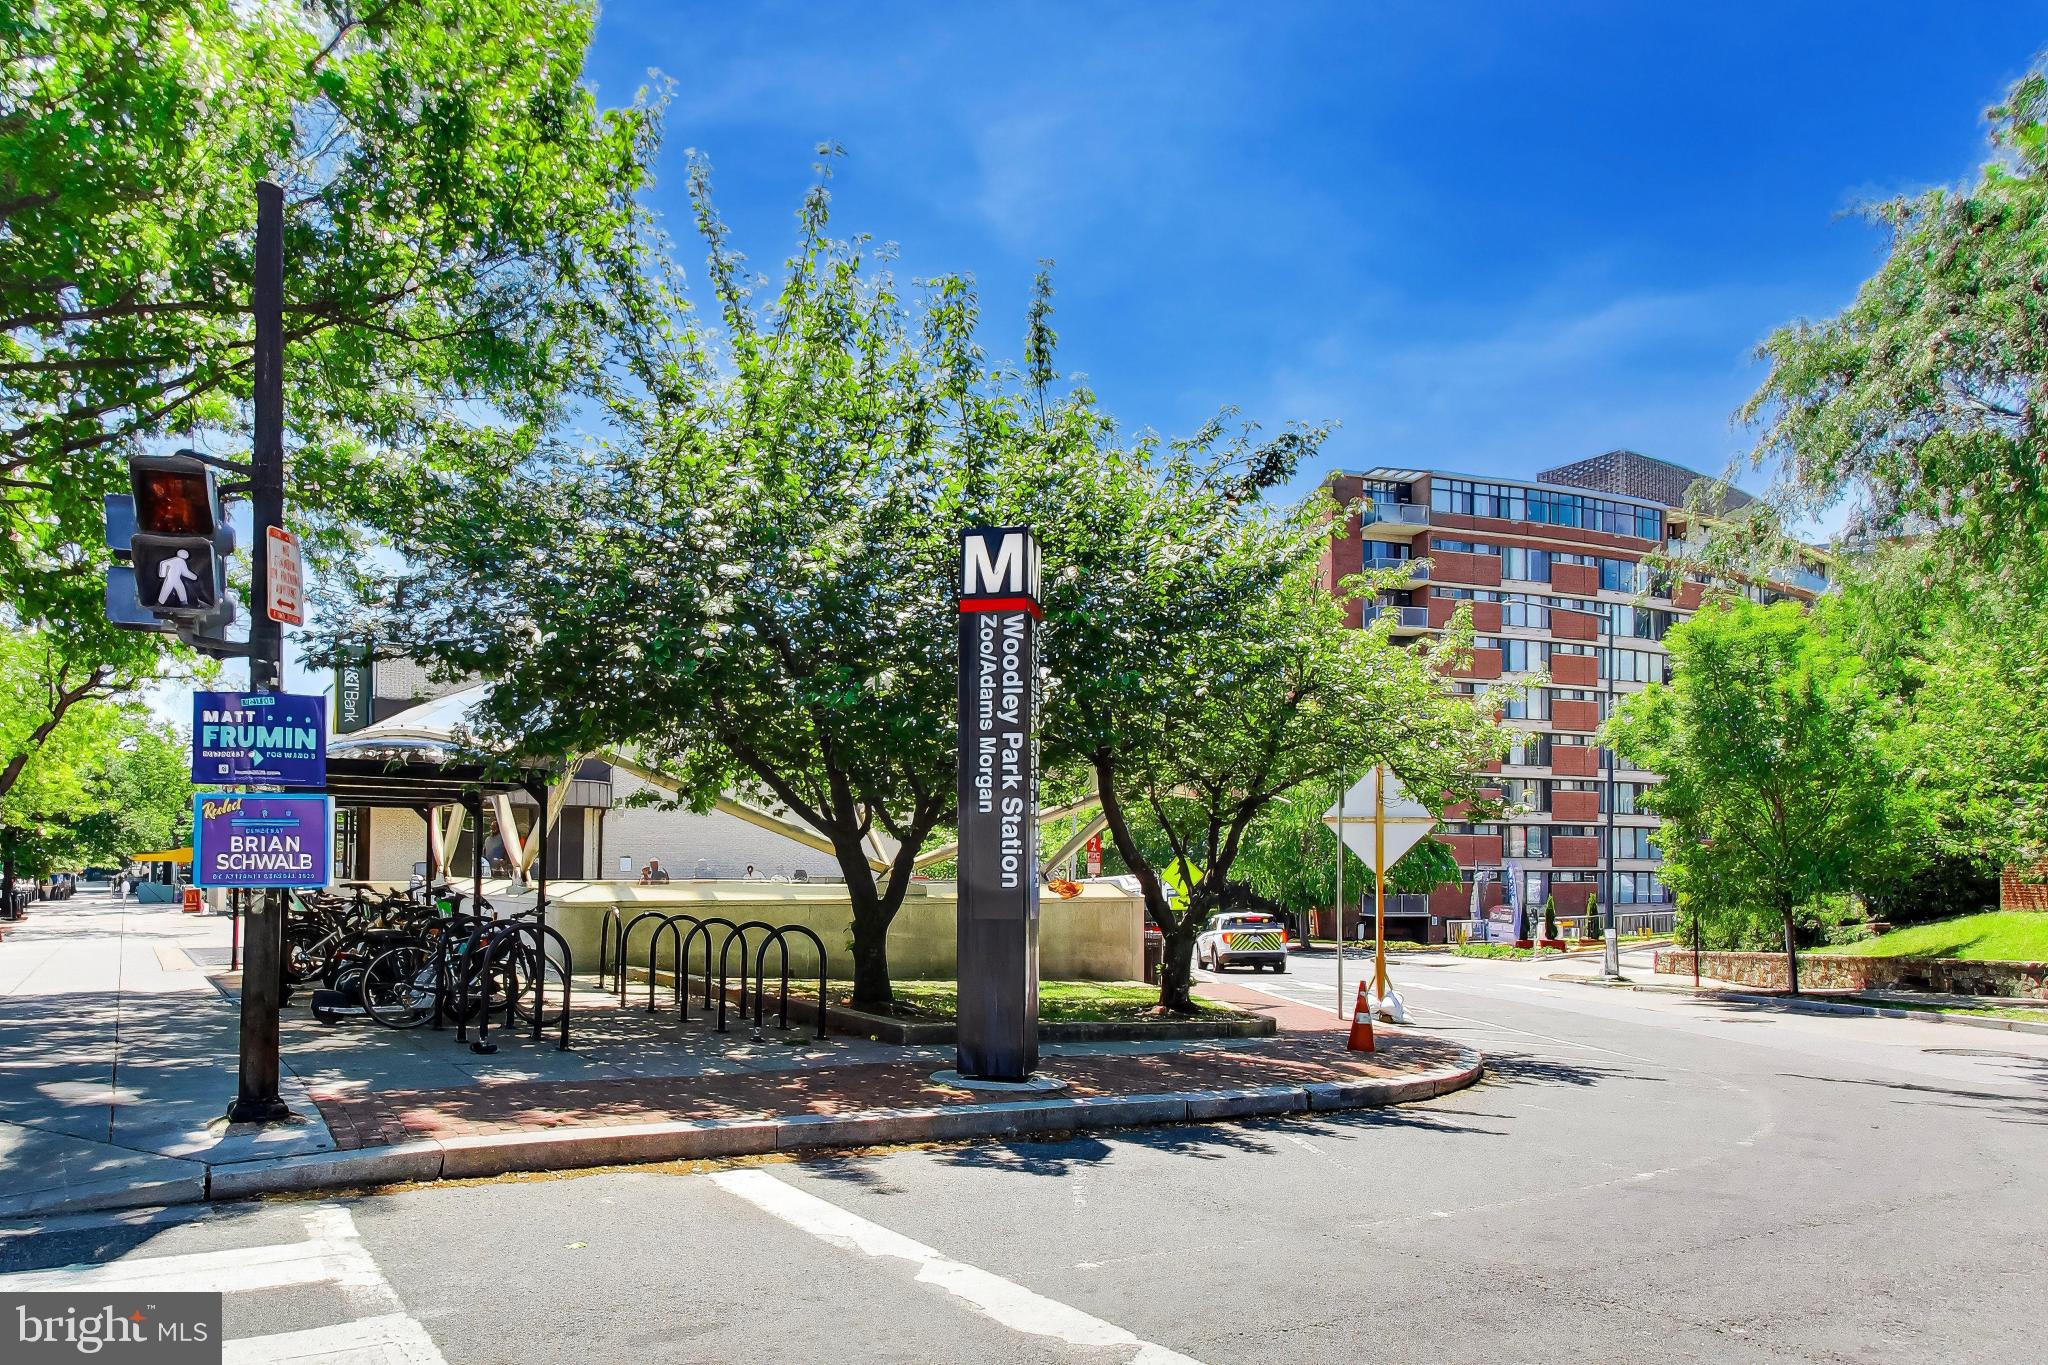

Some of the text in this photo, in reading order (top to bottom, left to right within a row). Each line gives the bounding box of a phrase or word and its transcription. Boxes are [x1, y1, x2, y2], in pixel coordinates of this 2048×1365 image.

[963, 533, 1023, 594] M
[1027, 534, 1042, 604] M
[202, 710, 256, 723] MATT
[344, 691, 359, 722] Bank
[975, 614, 998, 813] Zoo/Adams Morgan
[202, 725, 317, 750] FRUMIN
[997, 613, 1025, 888] Woodley Park Station
[230, 836, 300, 853] BRIAN
[216, 853, 313, 870] SCHWALB
